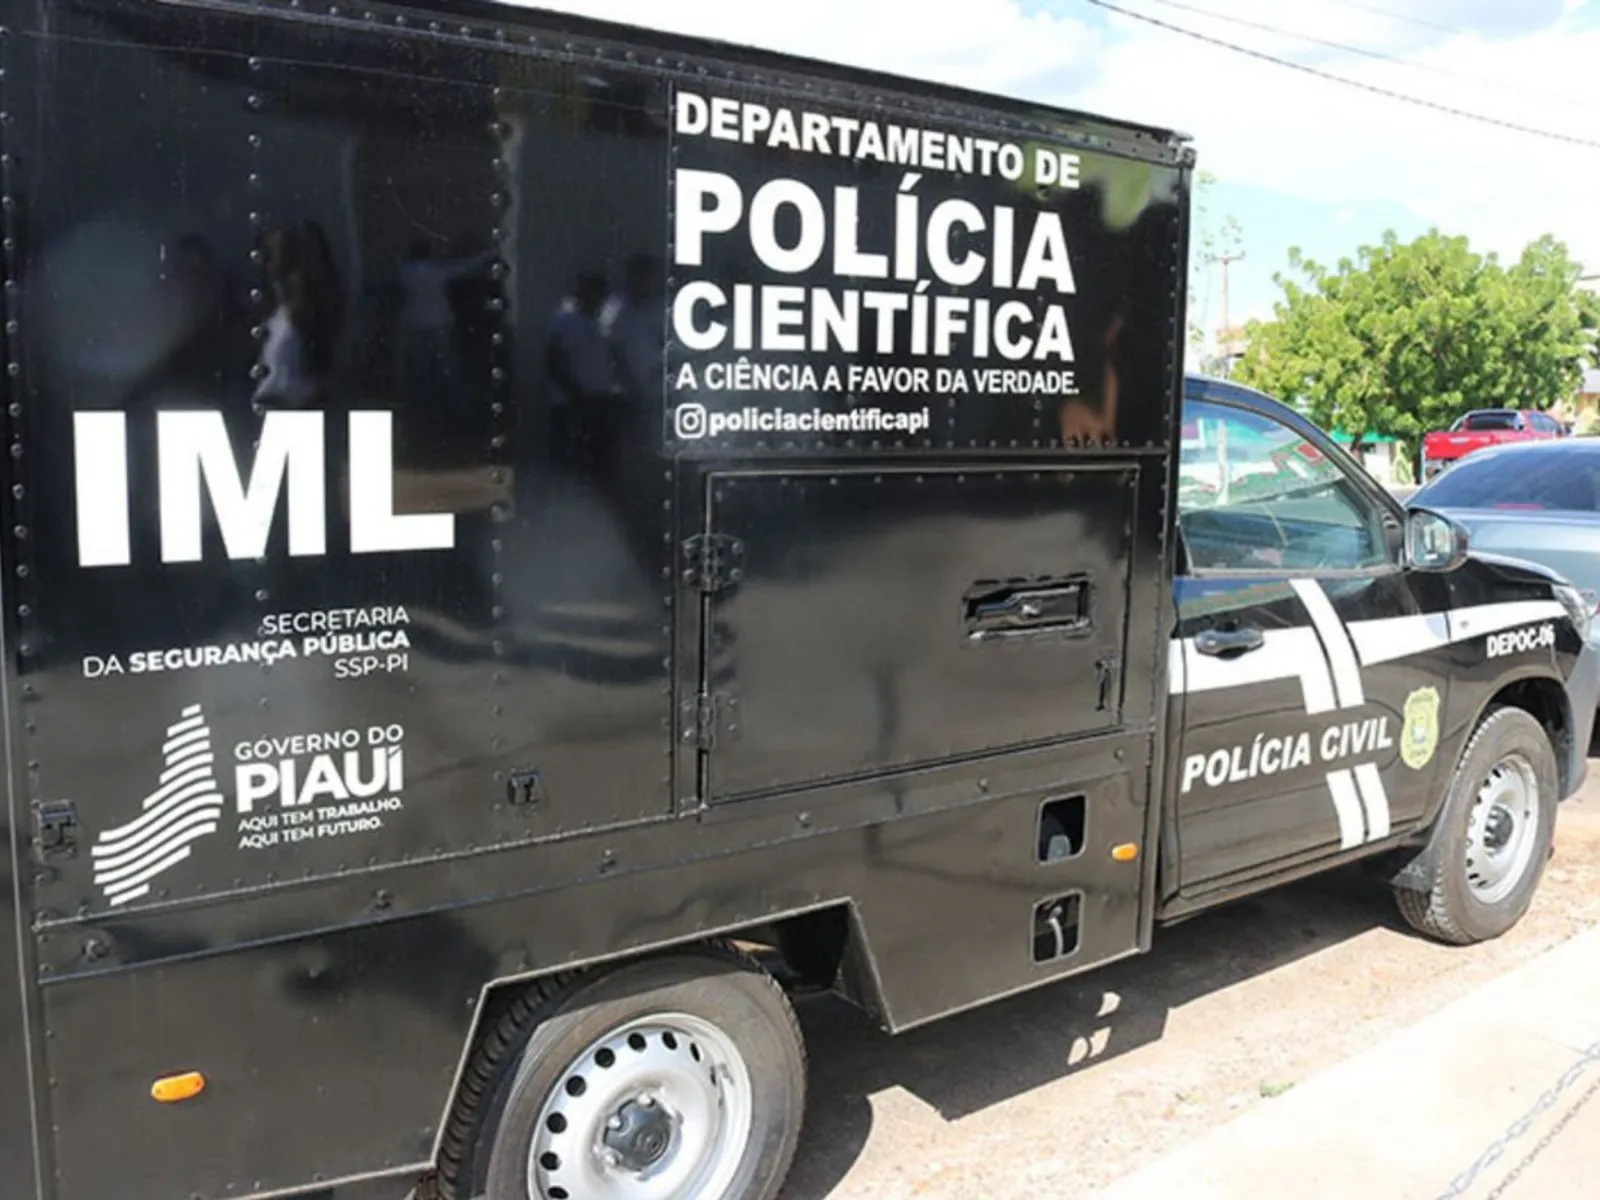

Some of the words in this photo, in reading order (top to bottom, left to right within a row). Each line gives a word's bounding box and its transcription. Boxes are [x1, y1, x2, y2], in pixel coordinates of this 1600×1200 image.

[675, 92, 1024, 180] DEPARTAMENTO
[1034, 149, 1081, 189] DE
[674, 168, 1077, 295] POLÍCIA
[672, 280, 1075, 363] CIENTÍFICA
[675, 363, 697, 390] A
[705, 357, 818, 392] CIÊNCIA
[822, 366, 842, 391] A
[848, 366, 929, 392] FAVOR
[936, 369, 969, 393] DA
[973, 370, 1080, 395] VERDADE.
[709, 408, 930, 436] policiacientificapi
[73, 410, 455, 567] IML
[262, 605, 410, 635] SECRETARIA
[82, 656, 125, 678] DA
[128, 639, 297, 674] SEGURANÇA
[303, 630, 411, 657] PÚBLICA
[334, 654, 409, 678] SSP-PI
[234, 729, 360, 761] GOVERNO
[368, 724, 404, 745] DO
[1180, 733, 1312, 794] POLÍCIA
[1320, 716, 1394, 761] CIVIL
[235, 745, 404, 813] PIAUÍ
[237, 816, 278, 832] AQUI
[282, 809, 314, 826] TEM
[318, 797, 403, 819] TRABALHO.
[238, 832, 278, 849] AQUI
[282, 827, 314, 843] TEM
[318, 816, 383, 838] FUTURO.
